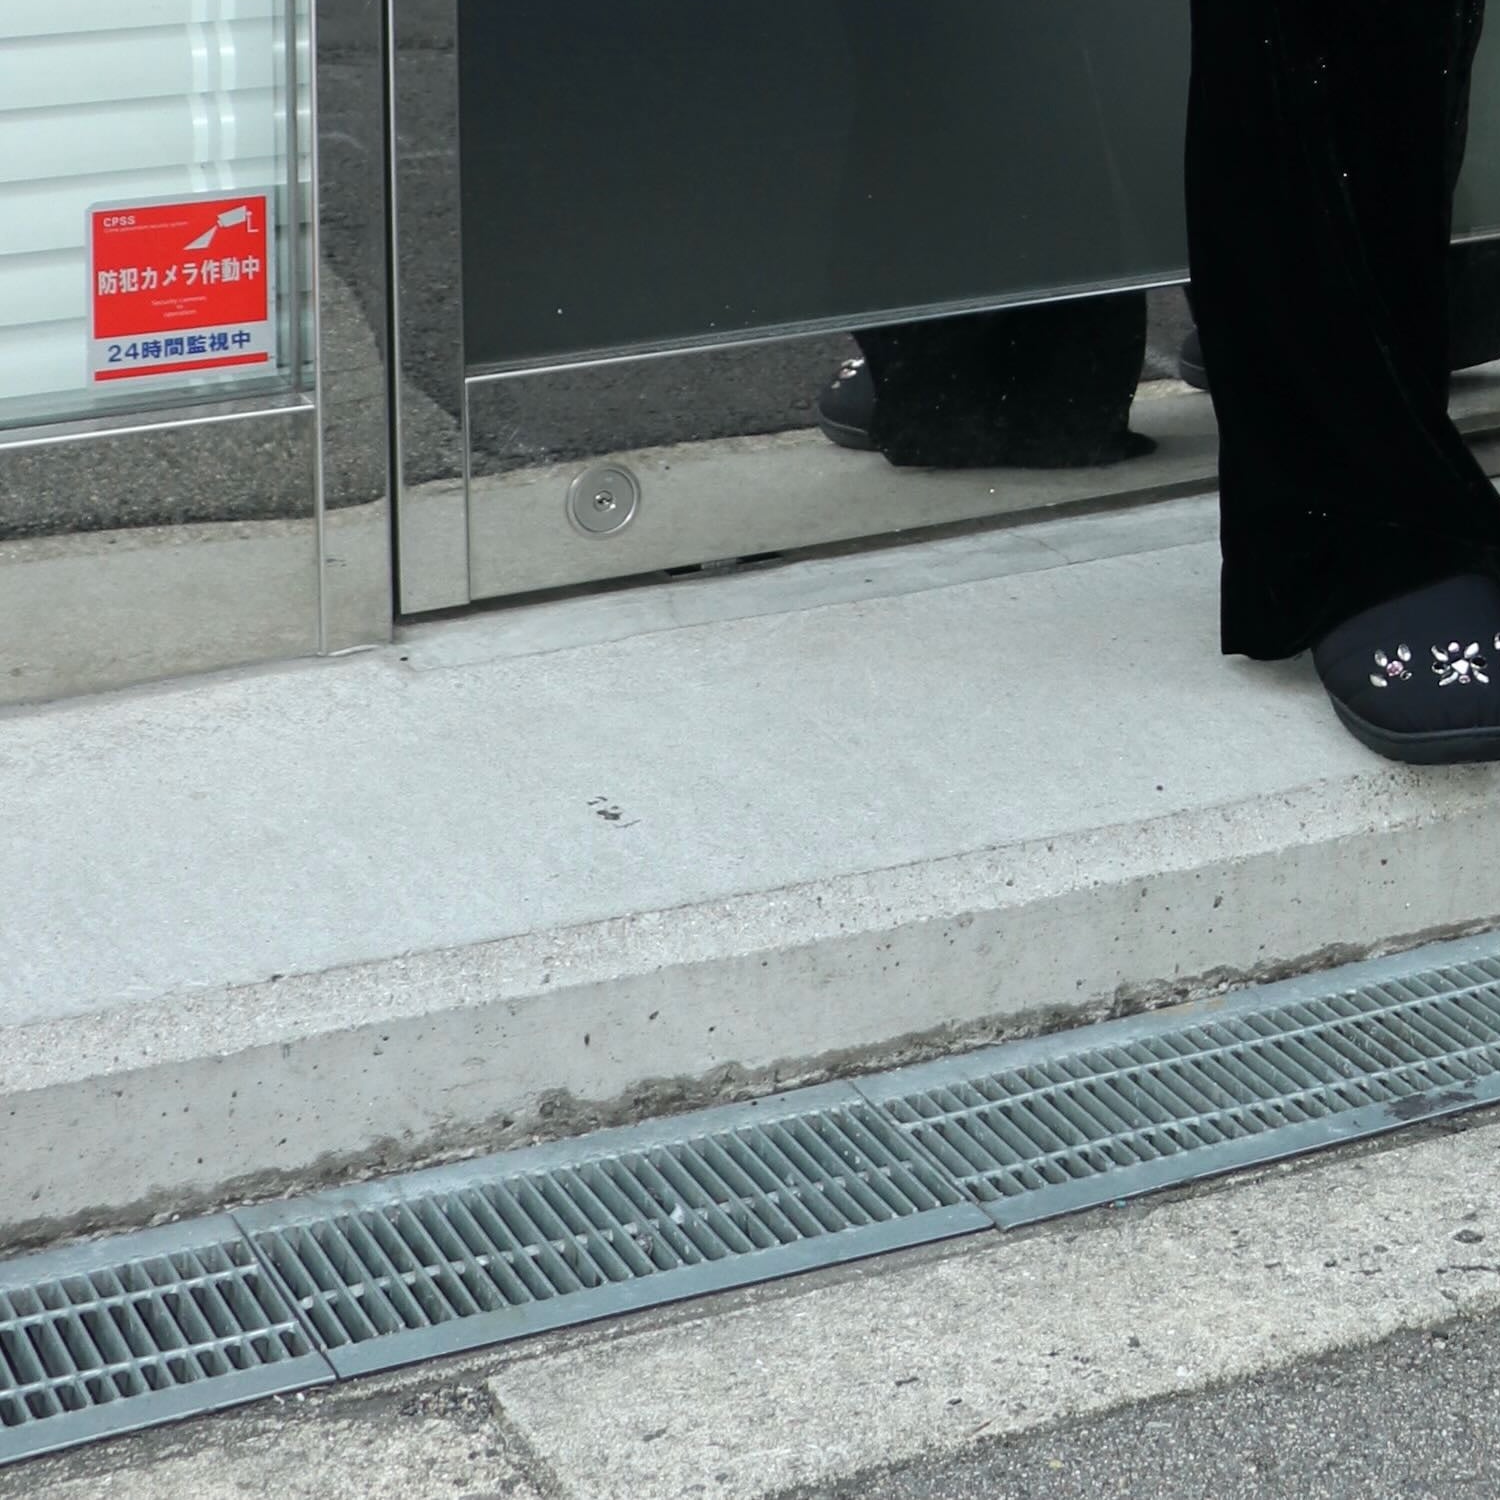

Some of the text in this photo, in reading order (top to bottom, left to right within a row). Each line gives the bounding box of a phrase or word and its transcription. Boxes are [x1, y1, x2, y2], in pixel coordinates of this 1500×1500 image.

[103, 215, 136, 228] CPSS
[97, 255, 261, 296] 防犯カメラ作動中
[107, 330, 252, 363] 24時間監視中
